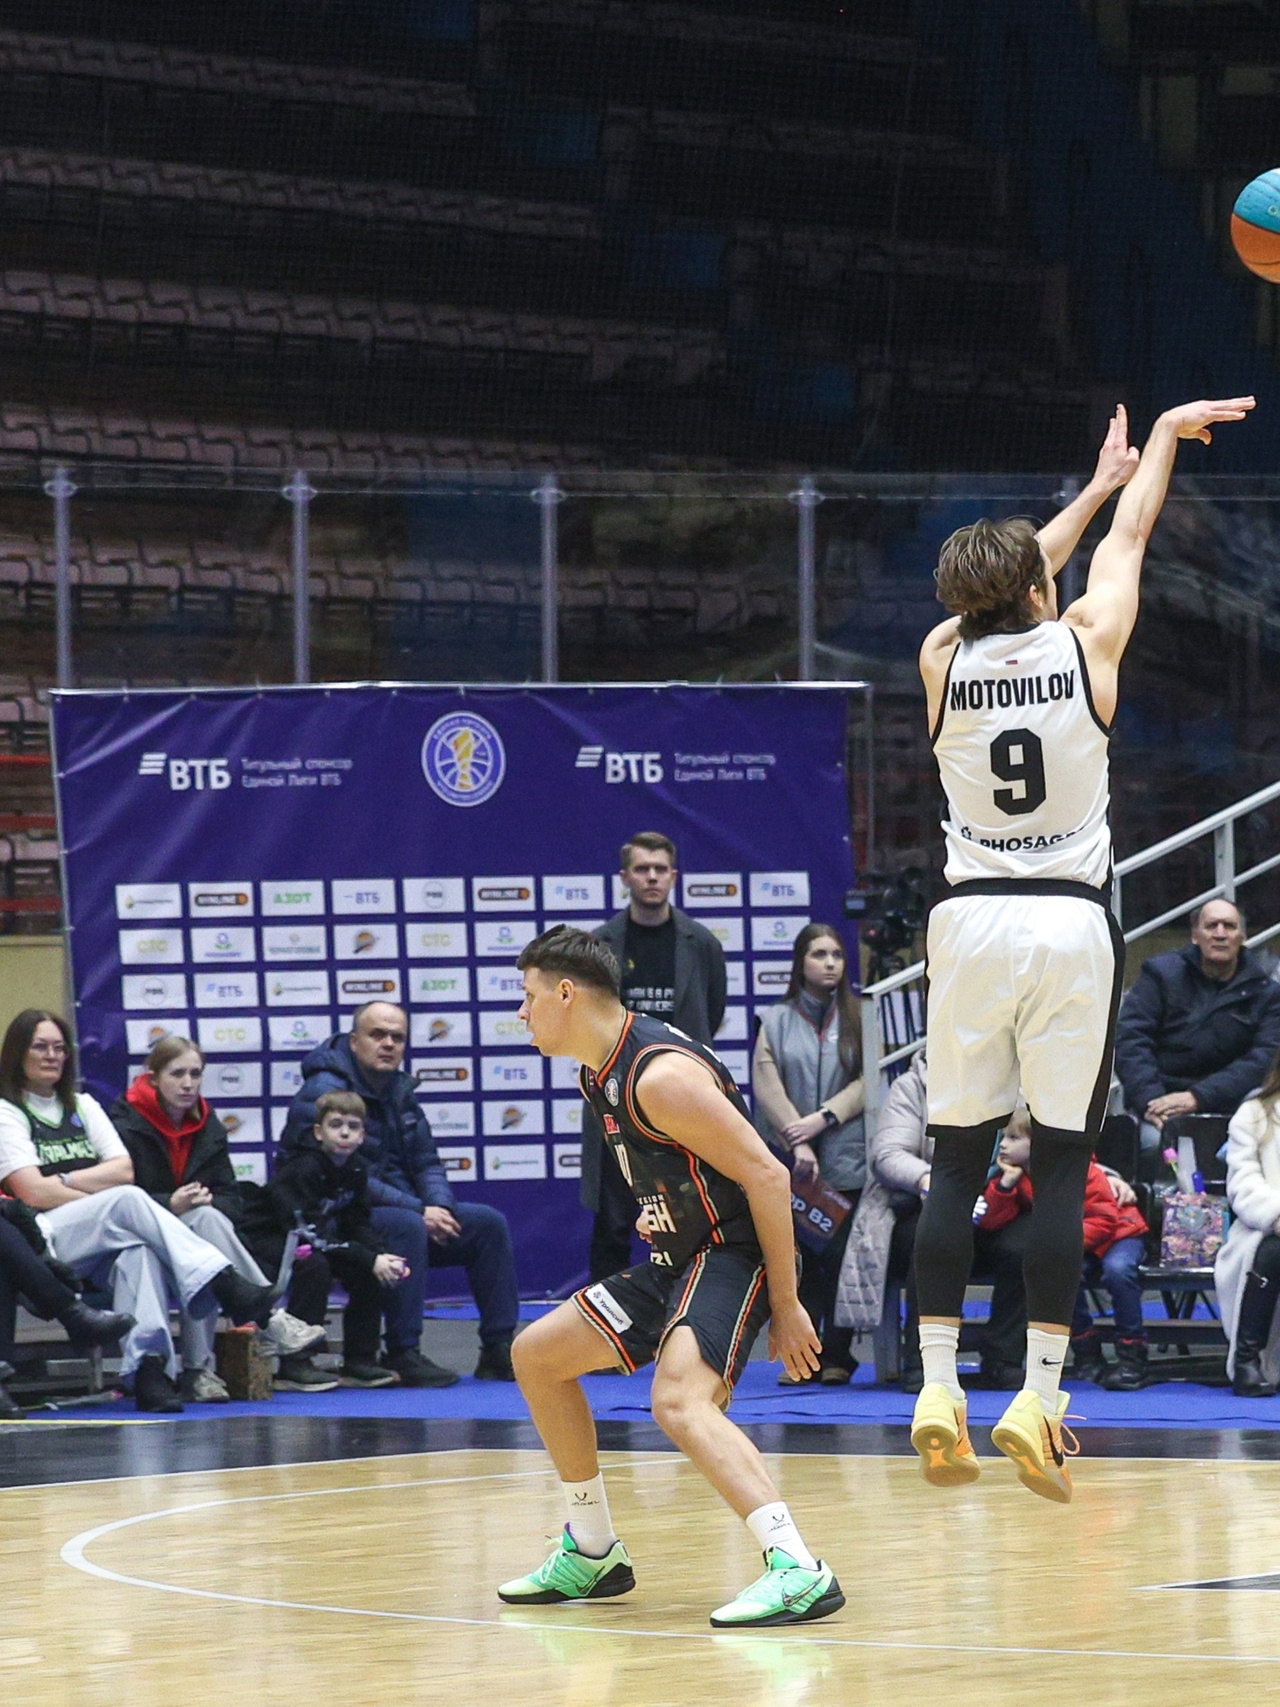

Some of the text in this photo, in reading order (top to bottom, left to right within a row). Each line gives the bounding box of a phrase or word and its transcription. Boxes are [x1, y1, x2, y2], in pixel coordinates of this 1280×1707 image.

[950, 669, 1075, 712] MOTOVILOV
[170, 758, 232, 791] ВТБ
[604, 751, 664, 784] ВТБ
[990, 727, 1047, 816] 9
